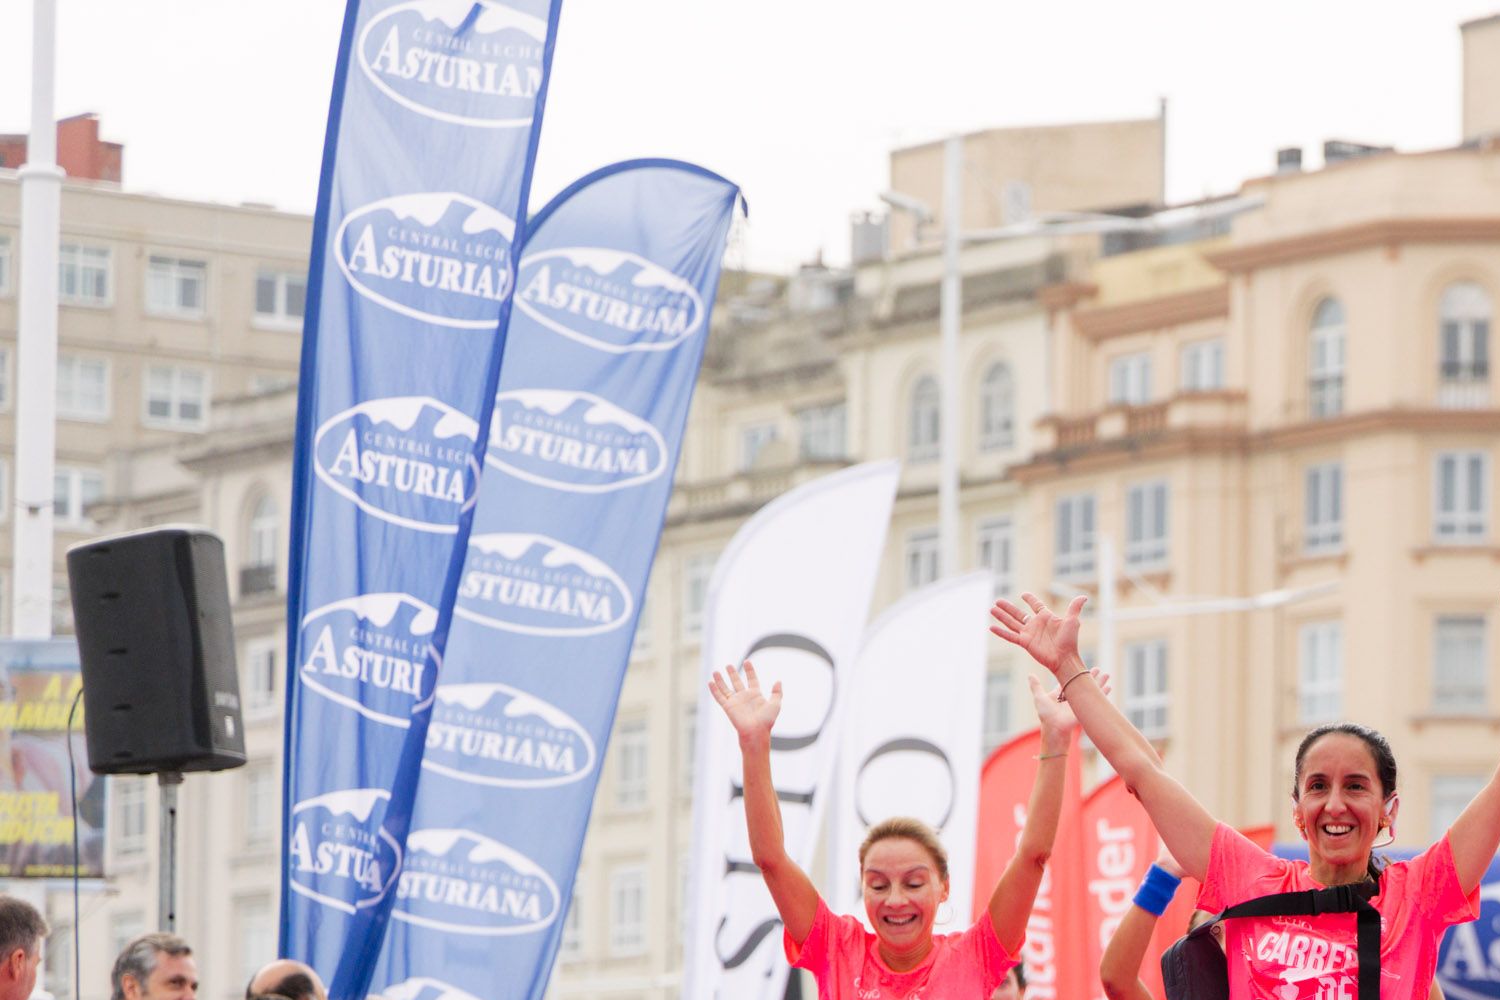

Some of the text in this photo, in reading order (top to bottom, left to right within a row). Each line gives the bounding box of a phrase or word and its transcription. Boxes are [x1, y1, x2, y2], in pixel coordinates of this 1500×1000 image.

[387, 226, 460, 253] CENTRAL
[521, 262, 689, 338] ASTURIANA
[363, 430, 432, 458] CENTRAL
